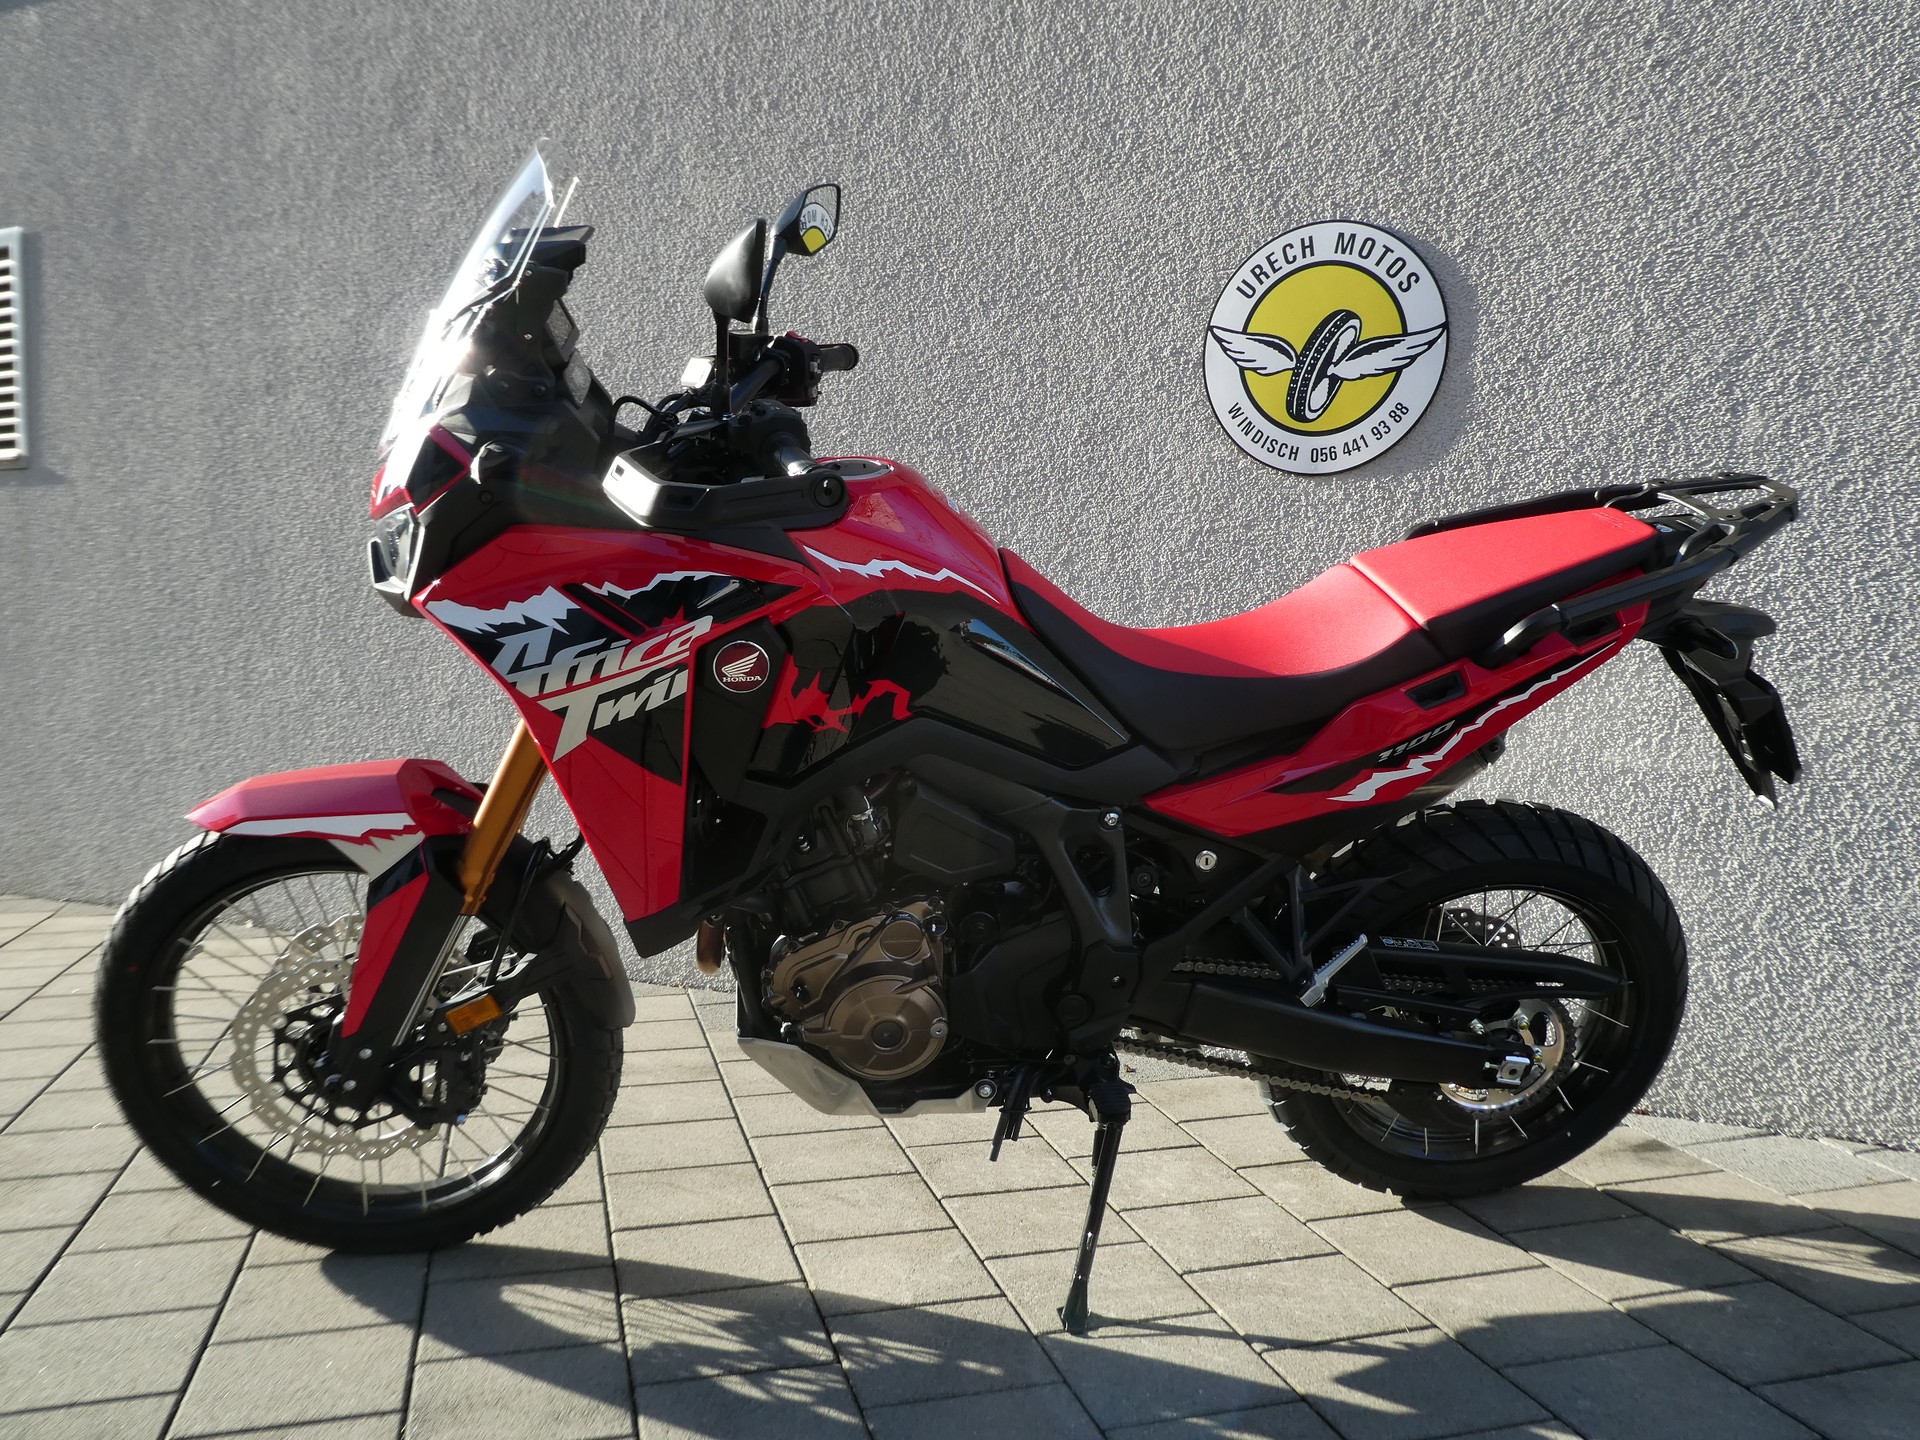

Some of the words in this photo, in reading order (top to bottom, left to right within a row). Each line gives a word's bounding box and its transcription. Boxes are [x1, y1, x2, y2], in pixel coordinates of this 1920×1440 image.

[1236, 235, 1315, 299] URECH
[1334, 232, 1420, 293] MOTOS
[1228, 402, 1300, 462] WINDISCH
[1310, 446, 1338, 463] 056
[1342, 435, 1369, 457] 441
[1372, 420, 1391, 441] 93
[1389, 402, 1410, 424] 88
[490, 615, 714, 698] Africa
[722, 675, 762, 683] HONDA
[1378, 719, 1456, 763] 1100
